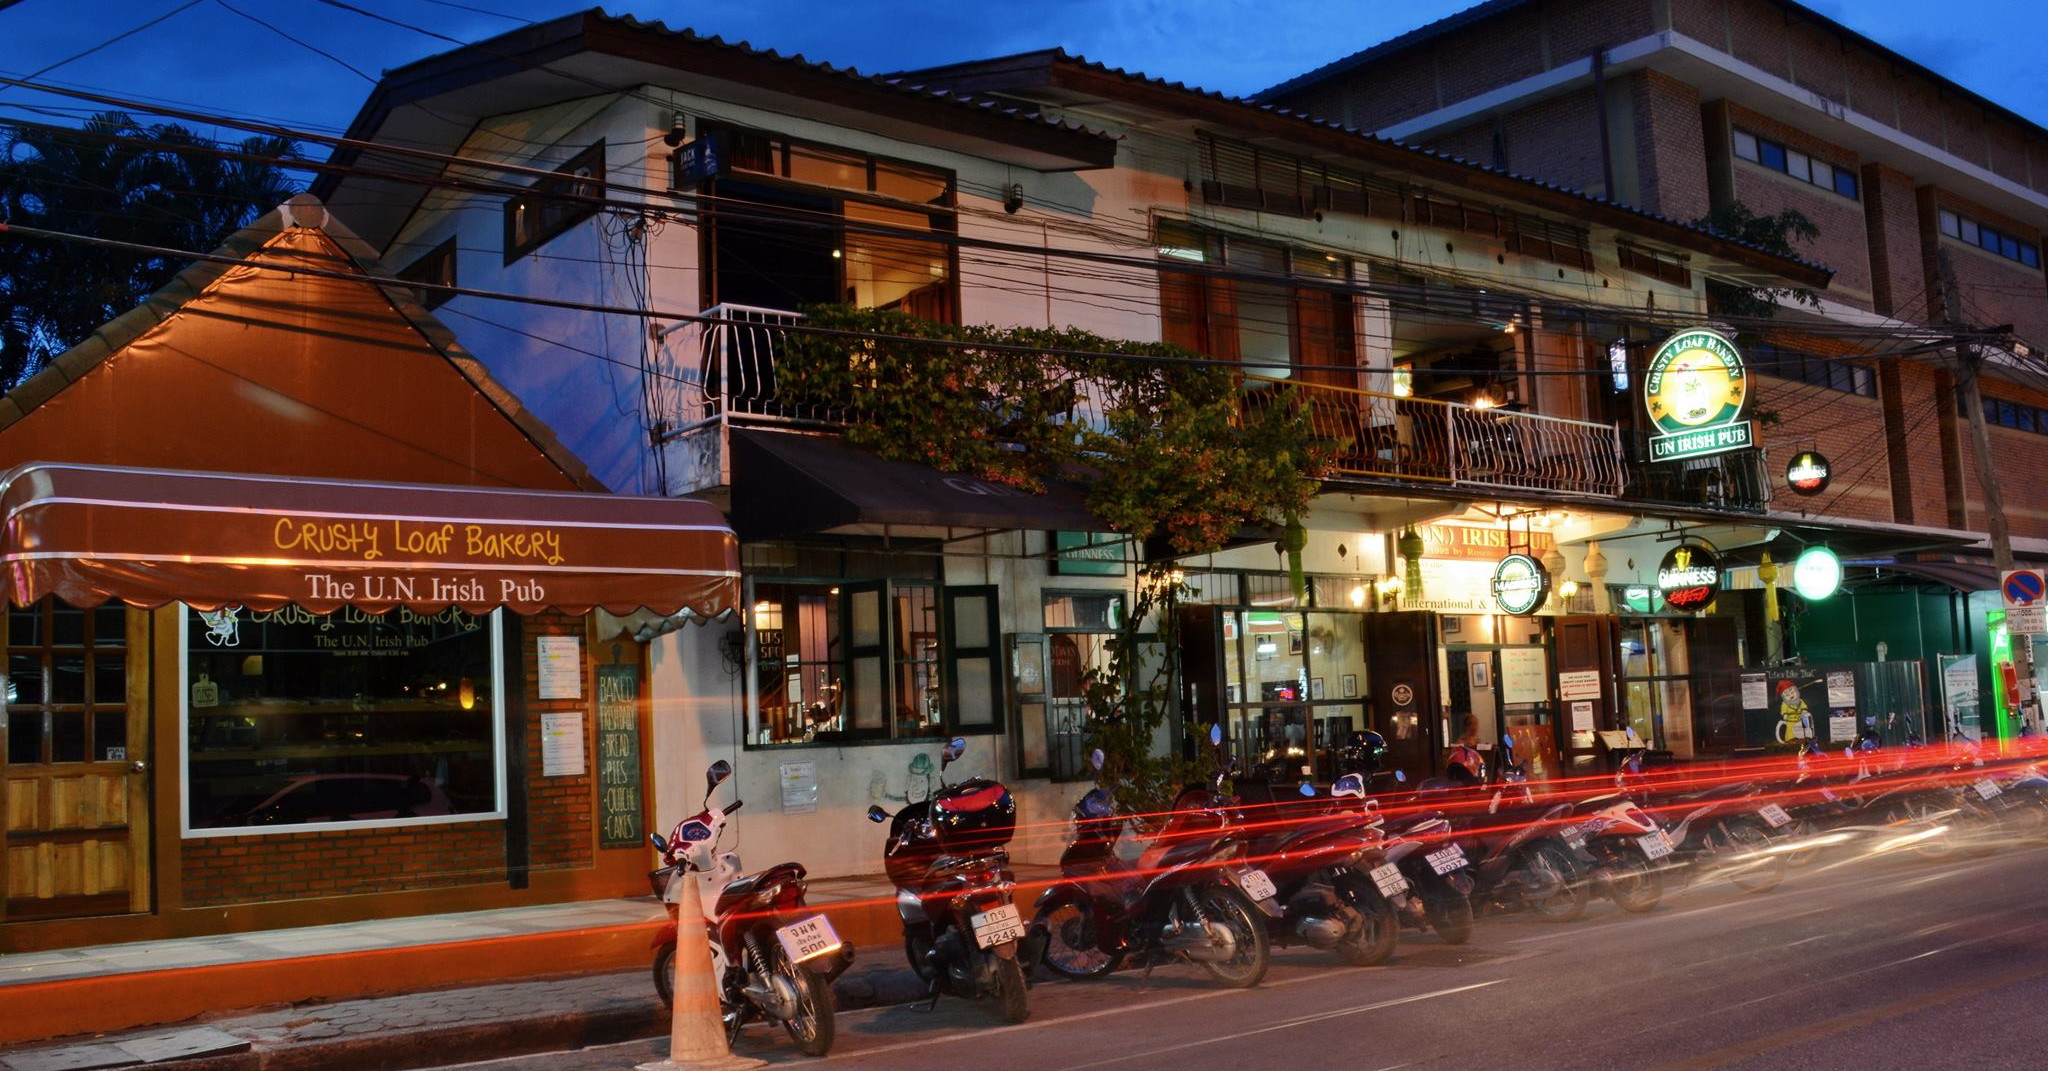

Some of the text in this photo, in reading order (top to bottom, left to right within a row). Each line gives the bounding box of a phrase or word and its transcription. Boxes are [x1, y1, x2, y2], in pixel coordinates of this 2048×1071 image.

[1648, 337, 1740, 394] CRUSTY LOAF BAKERY
[1655, 428, 1746, 456] UN IRISH PUB
[395, 520, 454, 555] Loaf
[304, 574, 545, 602] The U.N. Irish Pub
[1402, 598, 1473, 610] International
[1478, 601, 1488, 610] &
[313, 634, 430, 648] The U.N. Irish Pub
[600, 675, 634, 702] BAKED
[606, 734, 630, 758] BREAD
[606, 760, 628, 785] PIES
[607, 786, 637, 814] QUICHE
[606, 815, 635, 840] CAKES
[800, 940, 827, 956] 500
[986, 928, 1017, 945] 4248
